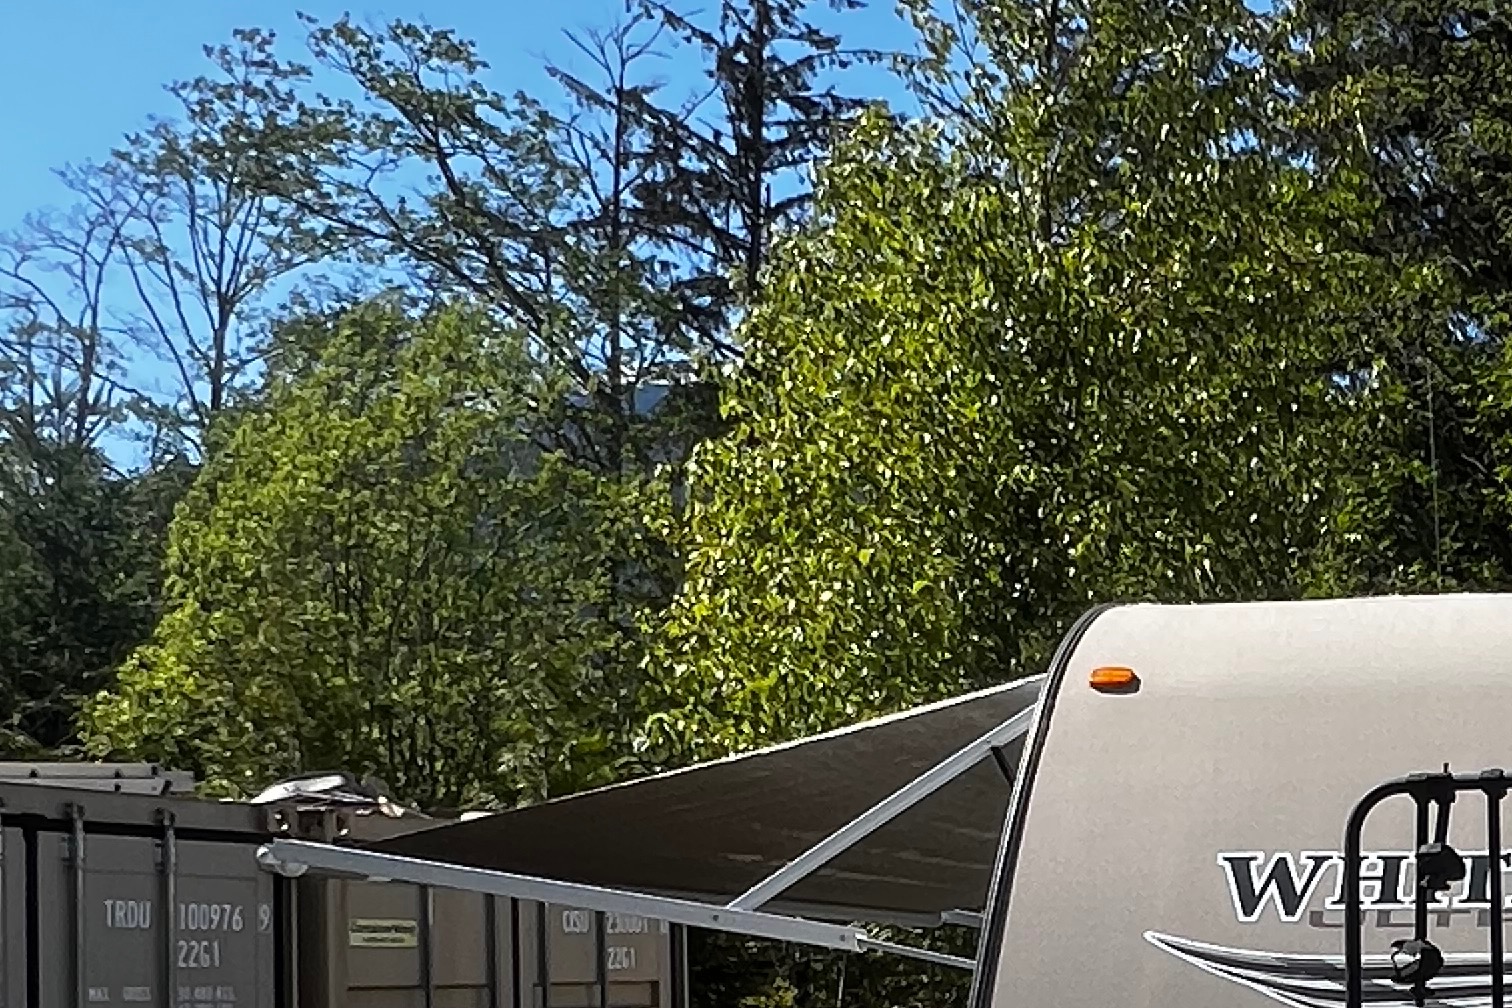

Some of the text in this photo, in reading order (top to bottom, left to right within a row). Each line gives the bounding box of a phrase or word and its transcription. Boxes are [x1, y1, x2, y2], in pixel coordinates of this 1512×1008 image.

[104, 899, 271, 931] TRDU 100976 9
